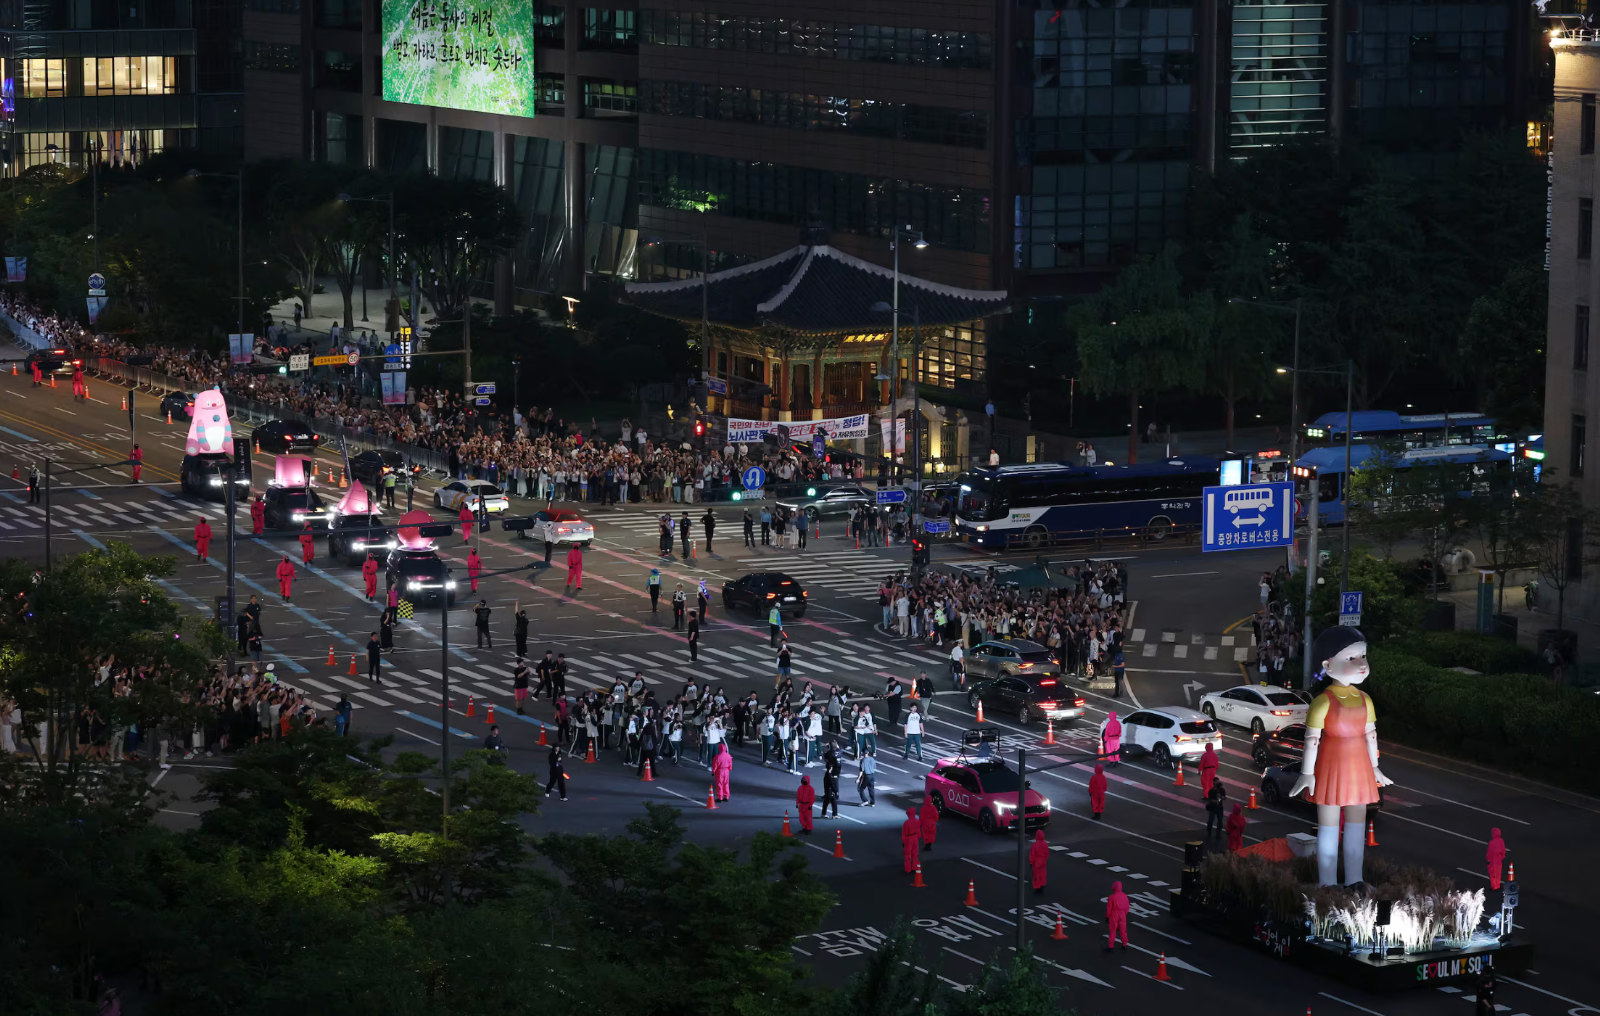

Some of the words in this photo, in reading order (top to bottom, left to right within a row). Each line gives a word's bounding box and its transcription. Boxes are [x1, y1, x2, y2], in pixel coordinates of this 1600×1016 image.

[411, 0, 436, 31] 여름은
[440, 1, 467, 32] 동사의
[471, 5, 494, 37] 계절
[730, 421, 752, 429] 국민의
[843, 415, 865, 429] 정답!
[1218, 529, 1279, 546] 중앙차로버스전용
[1253, 925, 1278, 946] 오징어
[1274, 935, 1290, 958] 게임
